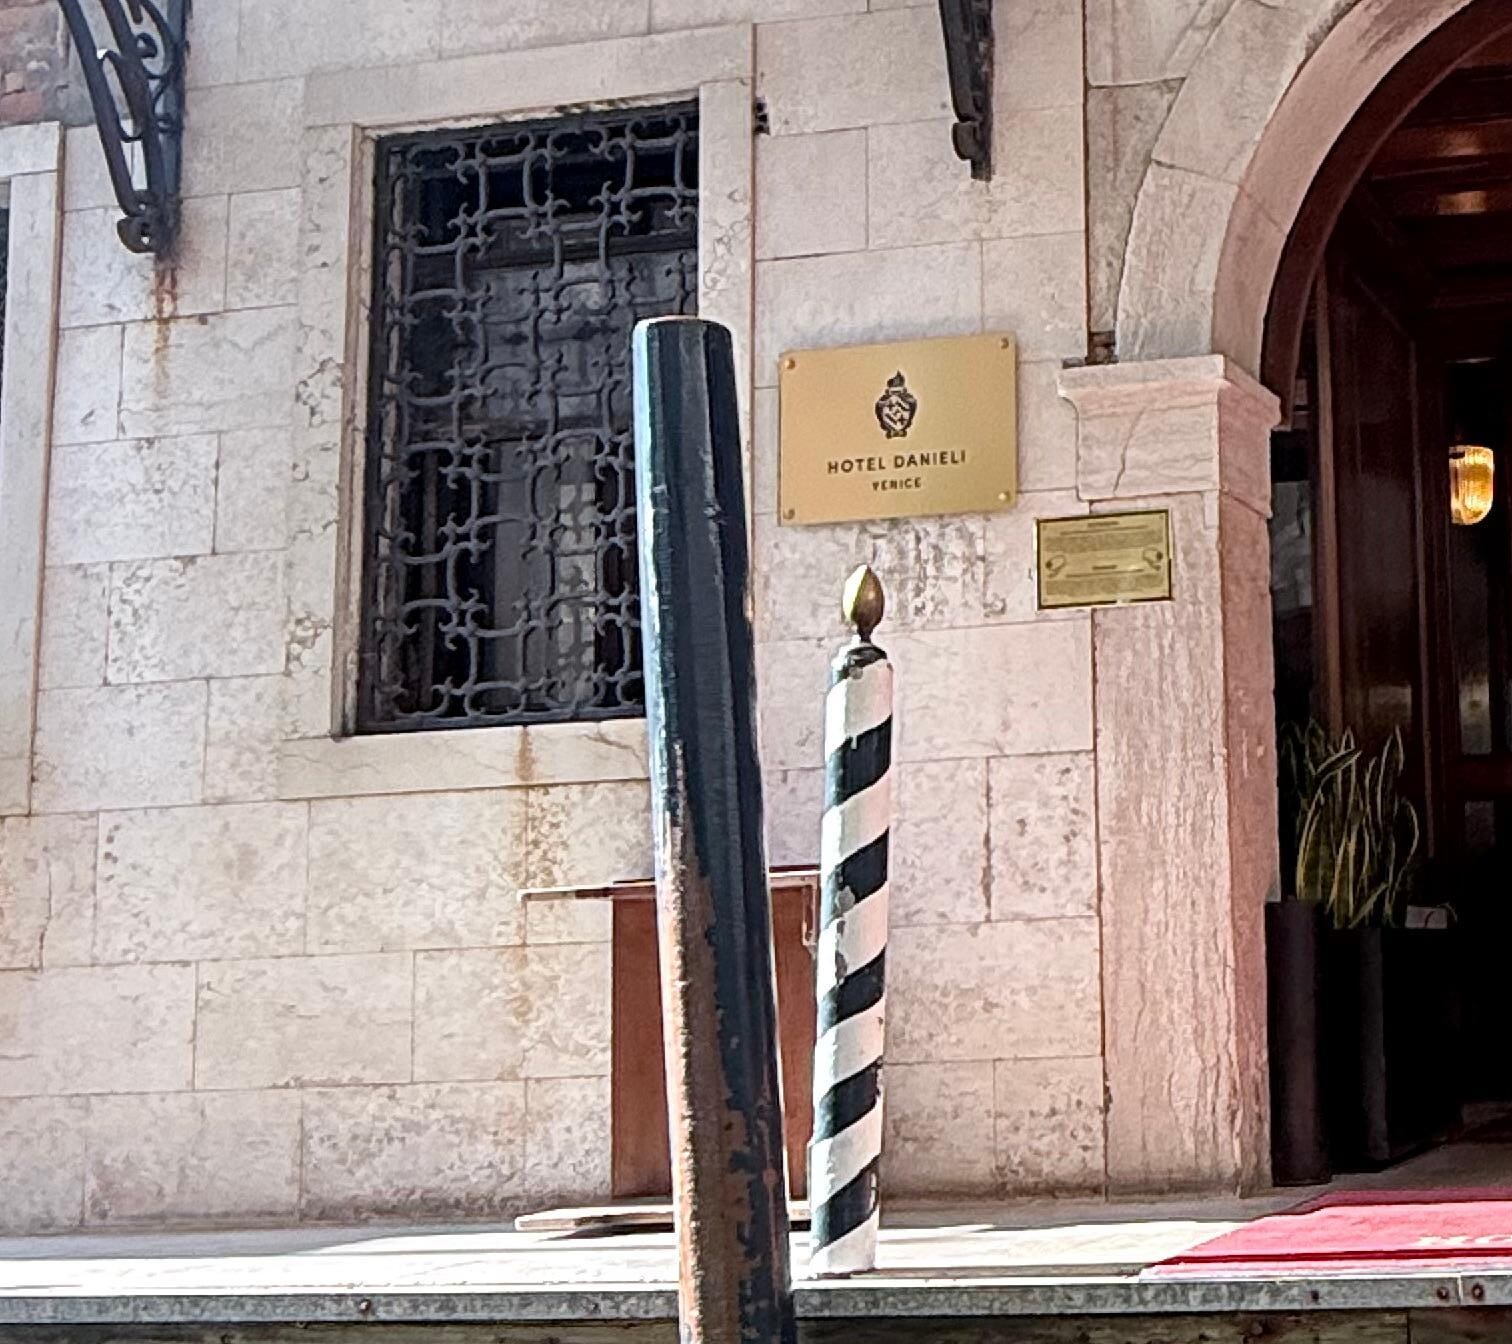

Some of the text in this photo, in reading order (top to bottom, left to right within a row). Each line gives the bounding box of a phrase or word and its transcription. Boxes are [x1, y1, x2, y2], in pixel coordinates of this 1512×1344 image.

[827, 449, 966, 474] HOTEL DANIELI
[872, 477, 921, 491] VENICE
